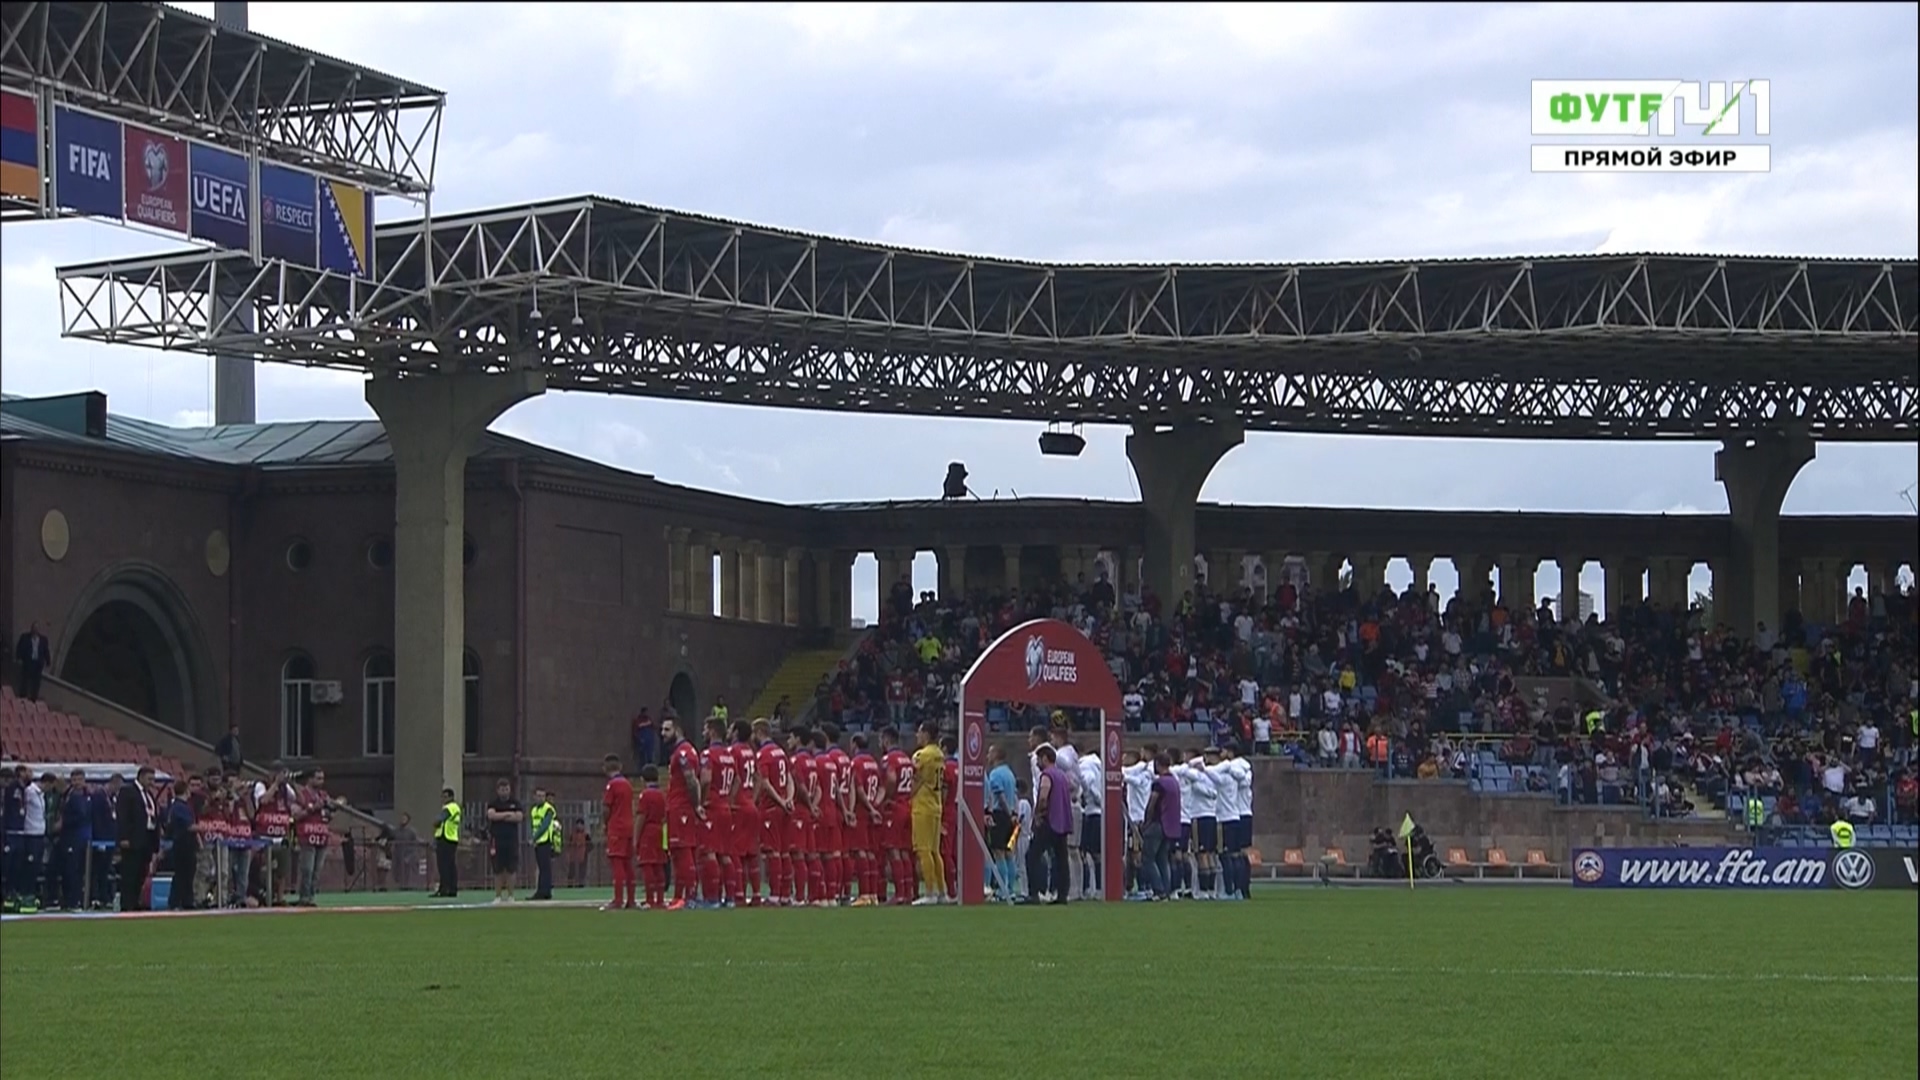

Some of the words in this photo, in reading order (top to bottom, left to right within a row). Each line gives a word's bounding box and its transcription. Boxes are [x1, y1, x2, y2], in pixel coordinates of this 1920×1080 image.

[69, 143, 111, 181] FIFA
[141, 193, 173, 211] EUROPEAN
[193, 174, 246, 220] UEFA
[137, 204, 177, 225] QUALIFIERS
[275, 203, 313, 227] RESPECT
[1047, 649, 1075, 665] EUROPEAN
[1043, 663, 1077, 682] QUALIFIERS
[779, 760, 786, 787] 3
[897, 767, 914, 792] 22
[1620, 850, 1826, 885] www.ffa.am
